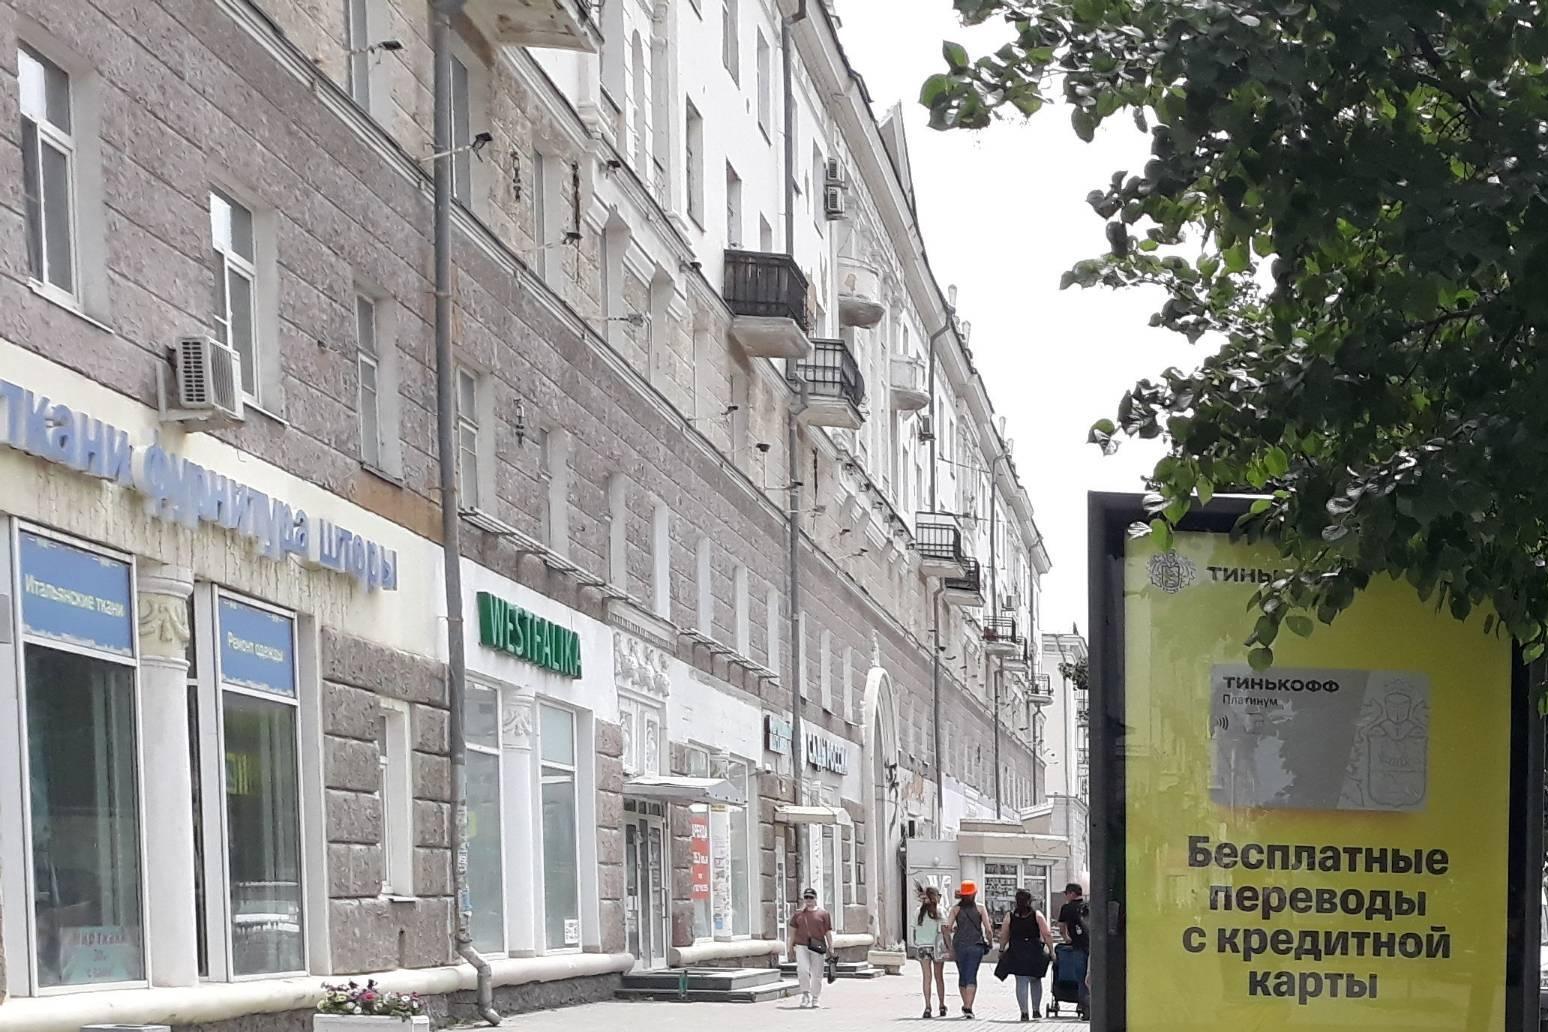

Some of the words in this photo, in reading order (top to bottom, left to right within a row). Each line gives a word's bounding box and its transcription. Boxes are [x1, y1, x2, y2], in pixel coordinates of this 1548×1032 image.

[1207, 566, 1278, 583] ТИНЬ
[479, 592, 581, 679] WESTFALIKA
[1222, 694, 1279, 708] Платинум
[1223, 676, 1340, 693] ТИНЬКОФФ
[1187, 835, 1449, 875] Бесплатные
[1209, 884, 1427, 921] переводы
[1182, 926, 1207, 953] с
[1217, 925, 1451, 962] кредитной
[1248, 970, 1379, 1006] карты
